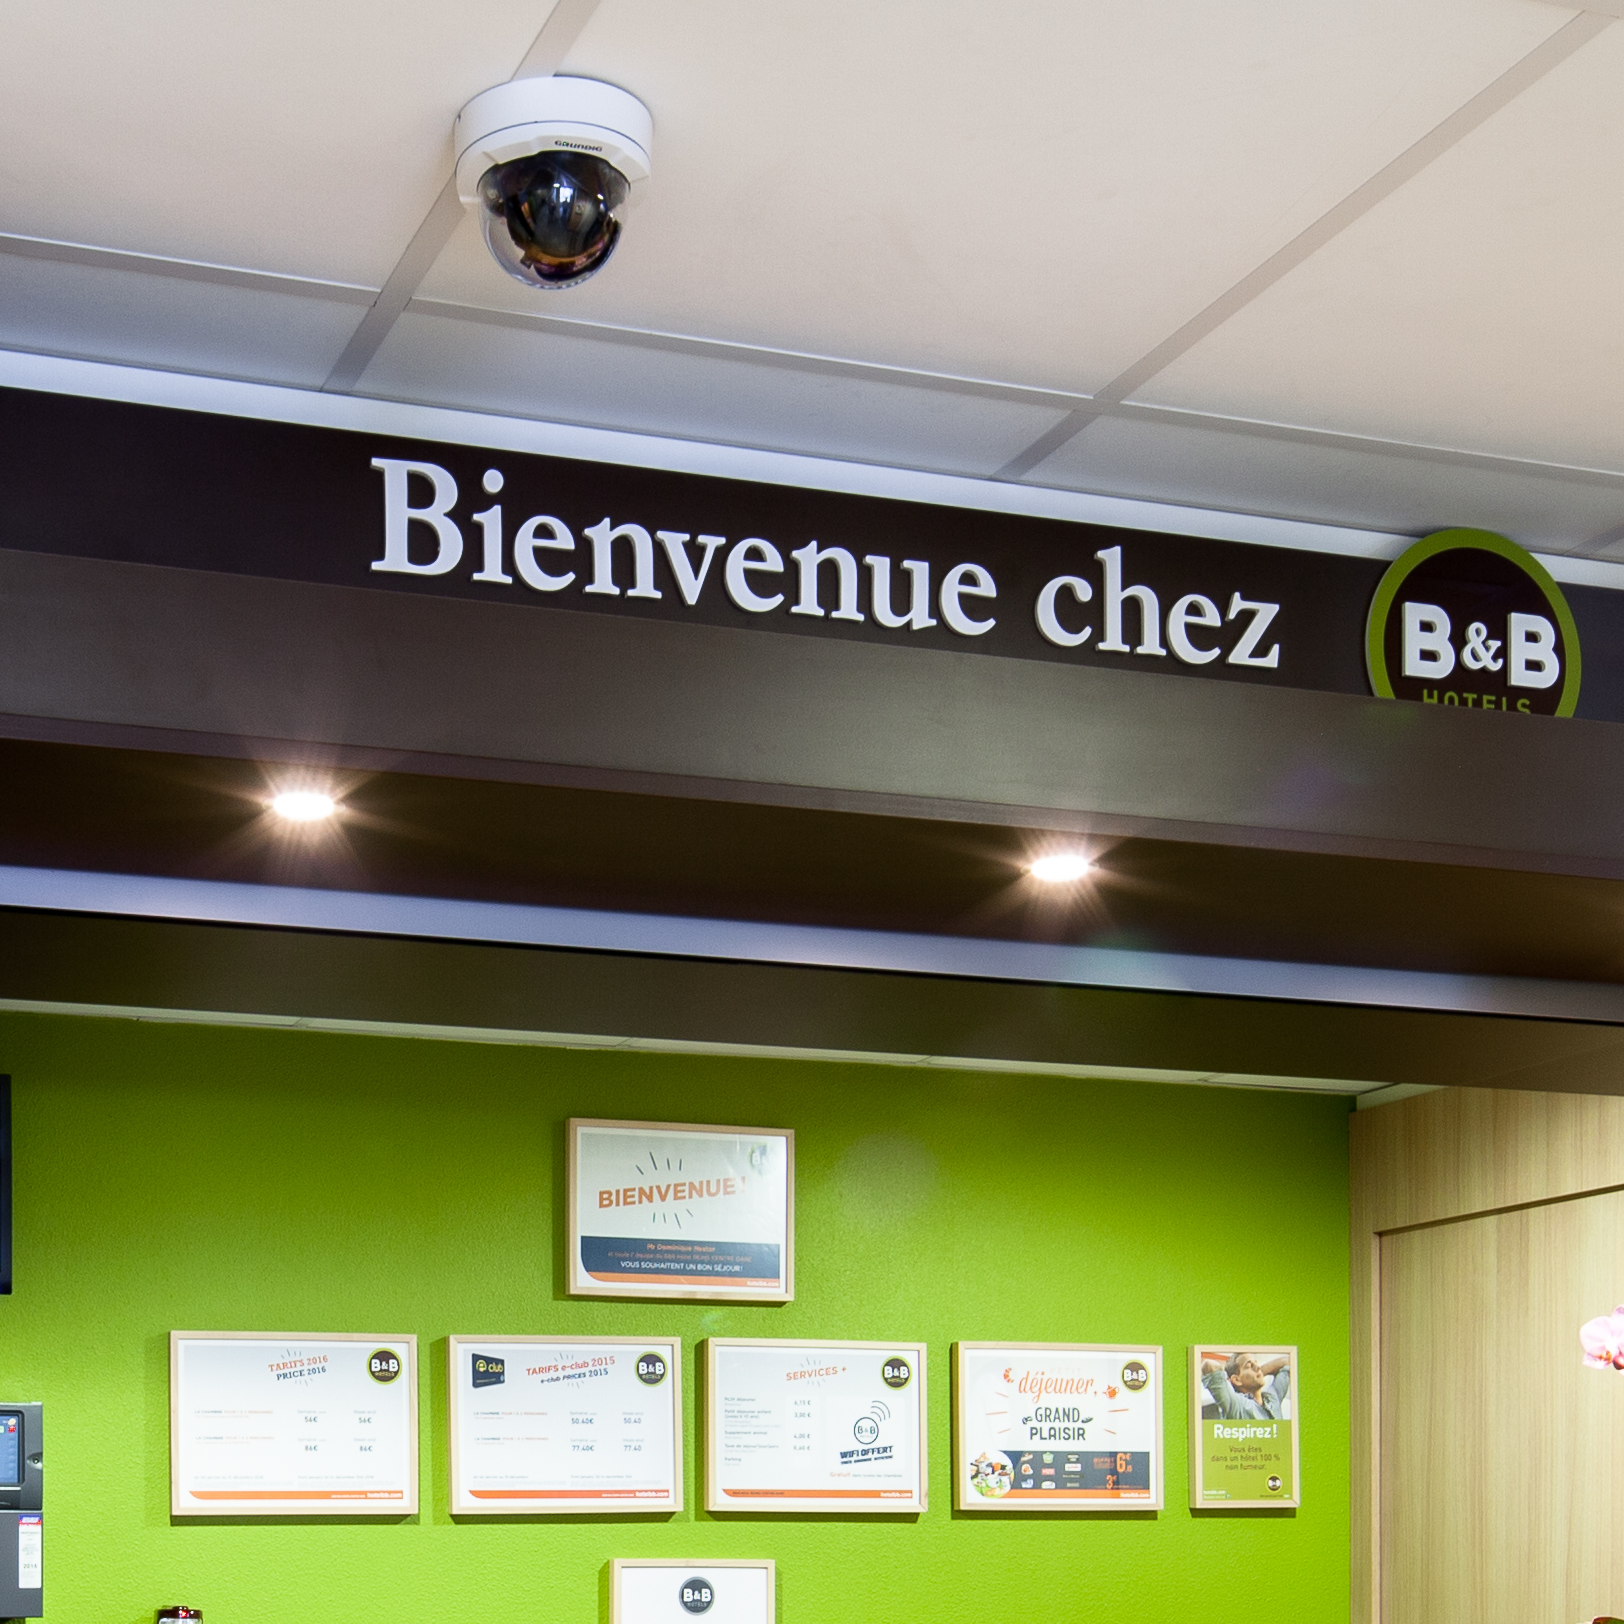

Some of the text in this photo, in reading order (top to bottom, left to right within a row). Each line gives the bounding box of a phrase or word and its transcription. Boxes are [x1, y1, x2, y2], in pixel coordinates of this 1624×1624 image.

[368, 456, 1281, 670] Bienvenue chez
[1401, 600, 1560, 690] B&B
[641, 1262, 684, 1270] SOUHAITENT
[697, 1263, 712, 1271] BON
[268, 1355, 329, 1373] TARIFS 2016
[371, 1358, 398, 1372] B&B
[526, 1356, 615, 1376] TARIFS e-club 2015
[639, 1361, 665, 1374] B&B
[883, 1365, 909, 1377] B&B
[276, 1366, 327, 1381] PRICE 2016
[541, 1376, 561, 1384] e-club
[589, 1368, 608, 1377] 2015
[786, 1366, 838, 1381] SERVICES
[1123, 1369, 1147, 1381] B&B
[1035, 1407, 1080, 1423] GRAND
[1030, 1427, 1086, 1441] PLAISIR
[840, 1445, 893, 1459] WIFI OFFERT
[1229, 1445, 1262, 1453] Vous êtes
[1240, 1453, 1258, 1462] hôtel
[683, 1588, 711, 1602] B&B
